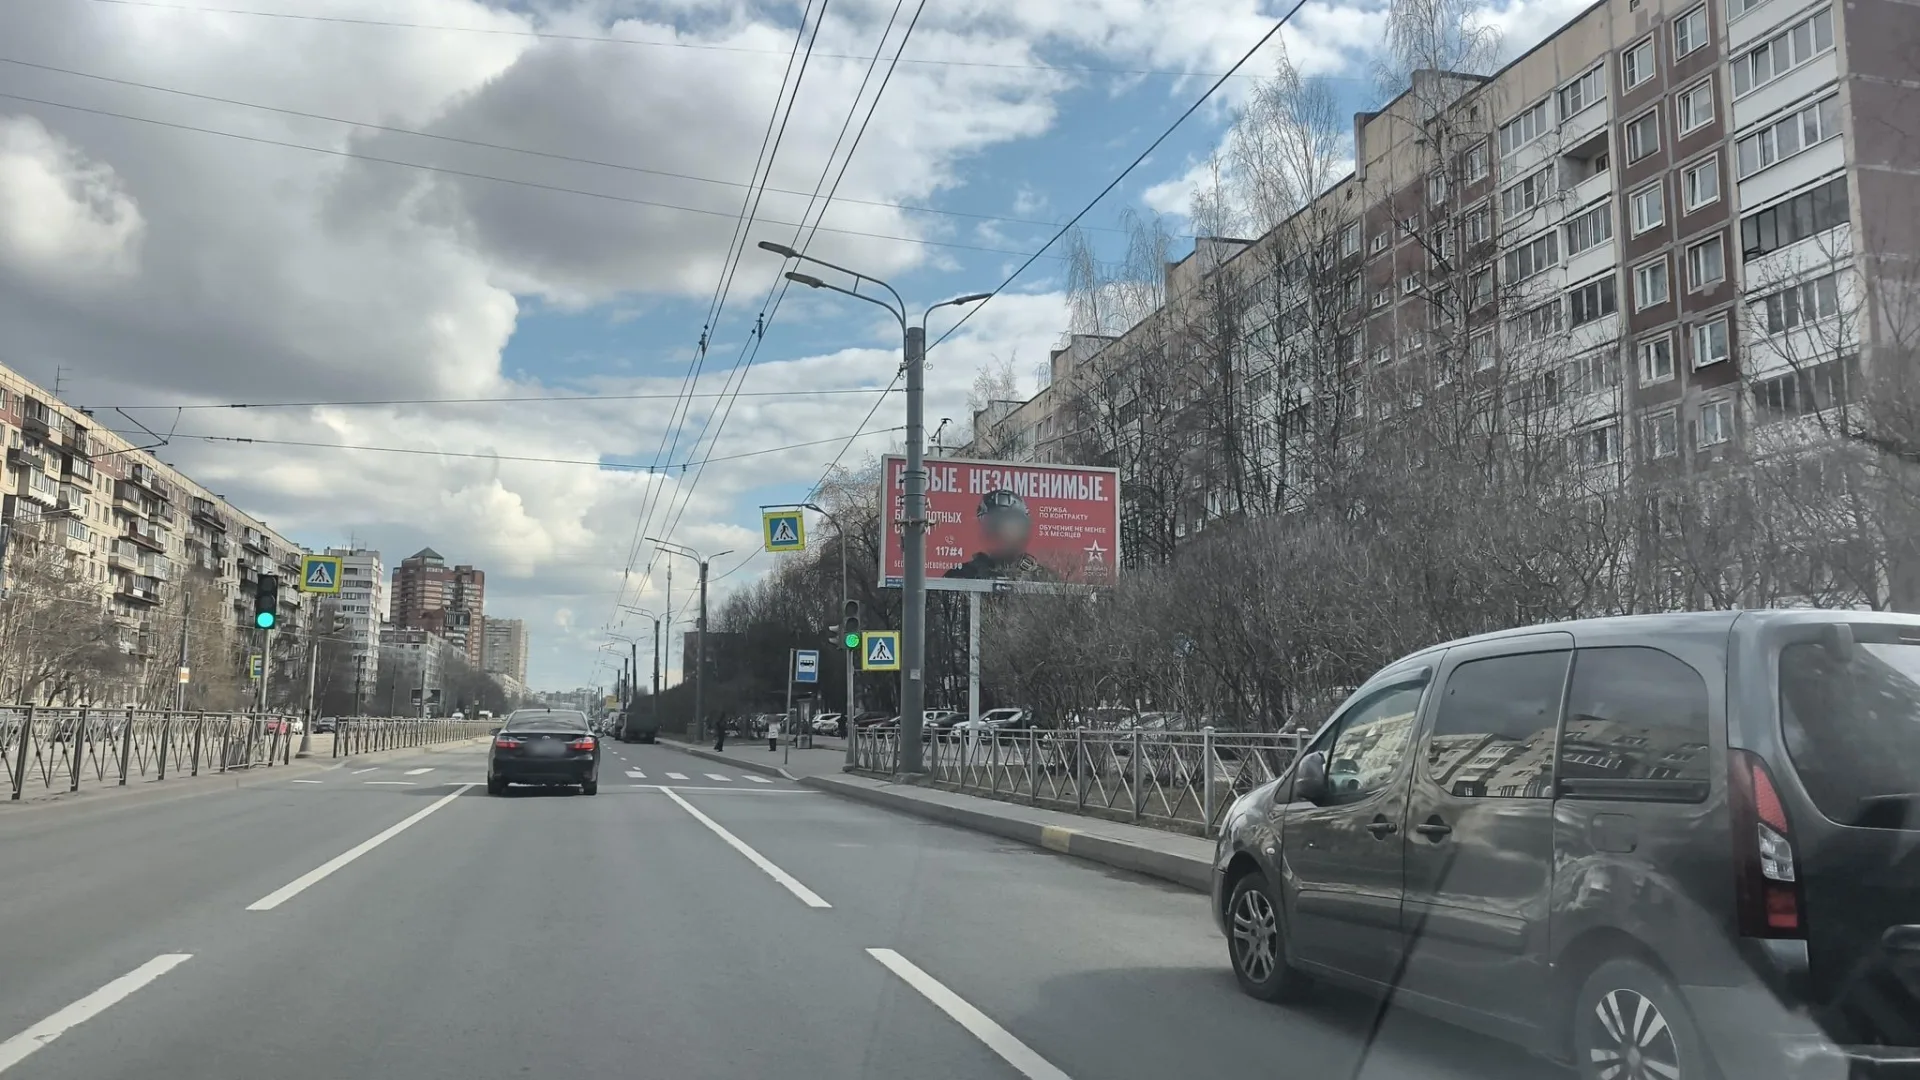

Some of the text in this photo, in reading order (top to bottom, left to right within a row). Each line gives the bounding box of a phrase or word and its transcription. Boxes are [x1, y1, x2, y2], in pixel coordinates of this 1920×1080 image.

[895, 464, 1108, 501] НВЫЕ. НЕЗАМЕНИМЫЕ.
[1050, 512, 1088, 520] КОНТРАКТУ
[1085, 526, 1106, 534] МЕНЕЕ
[935, 546, 963, 557] 117#4
